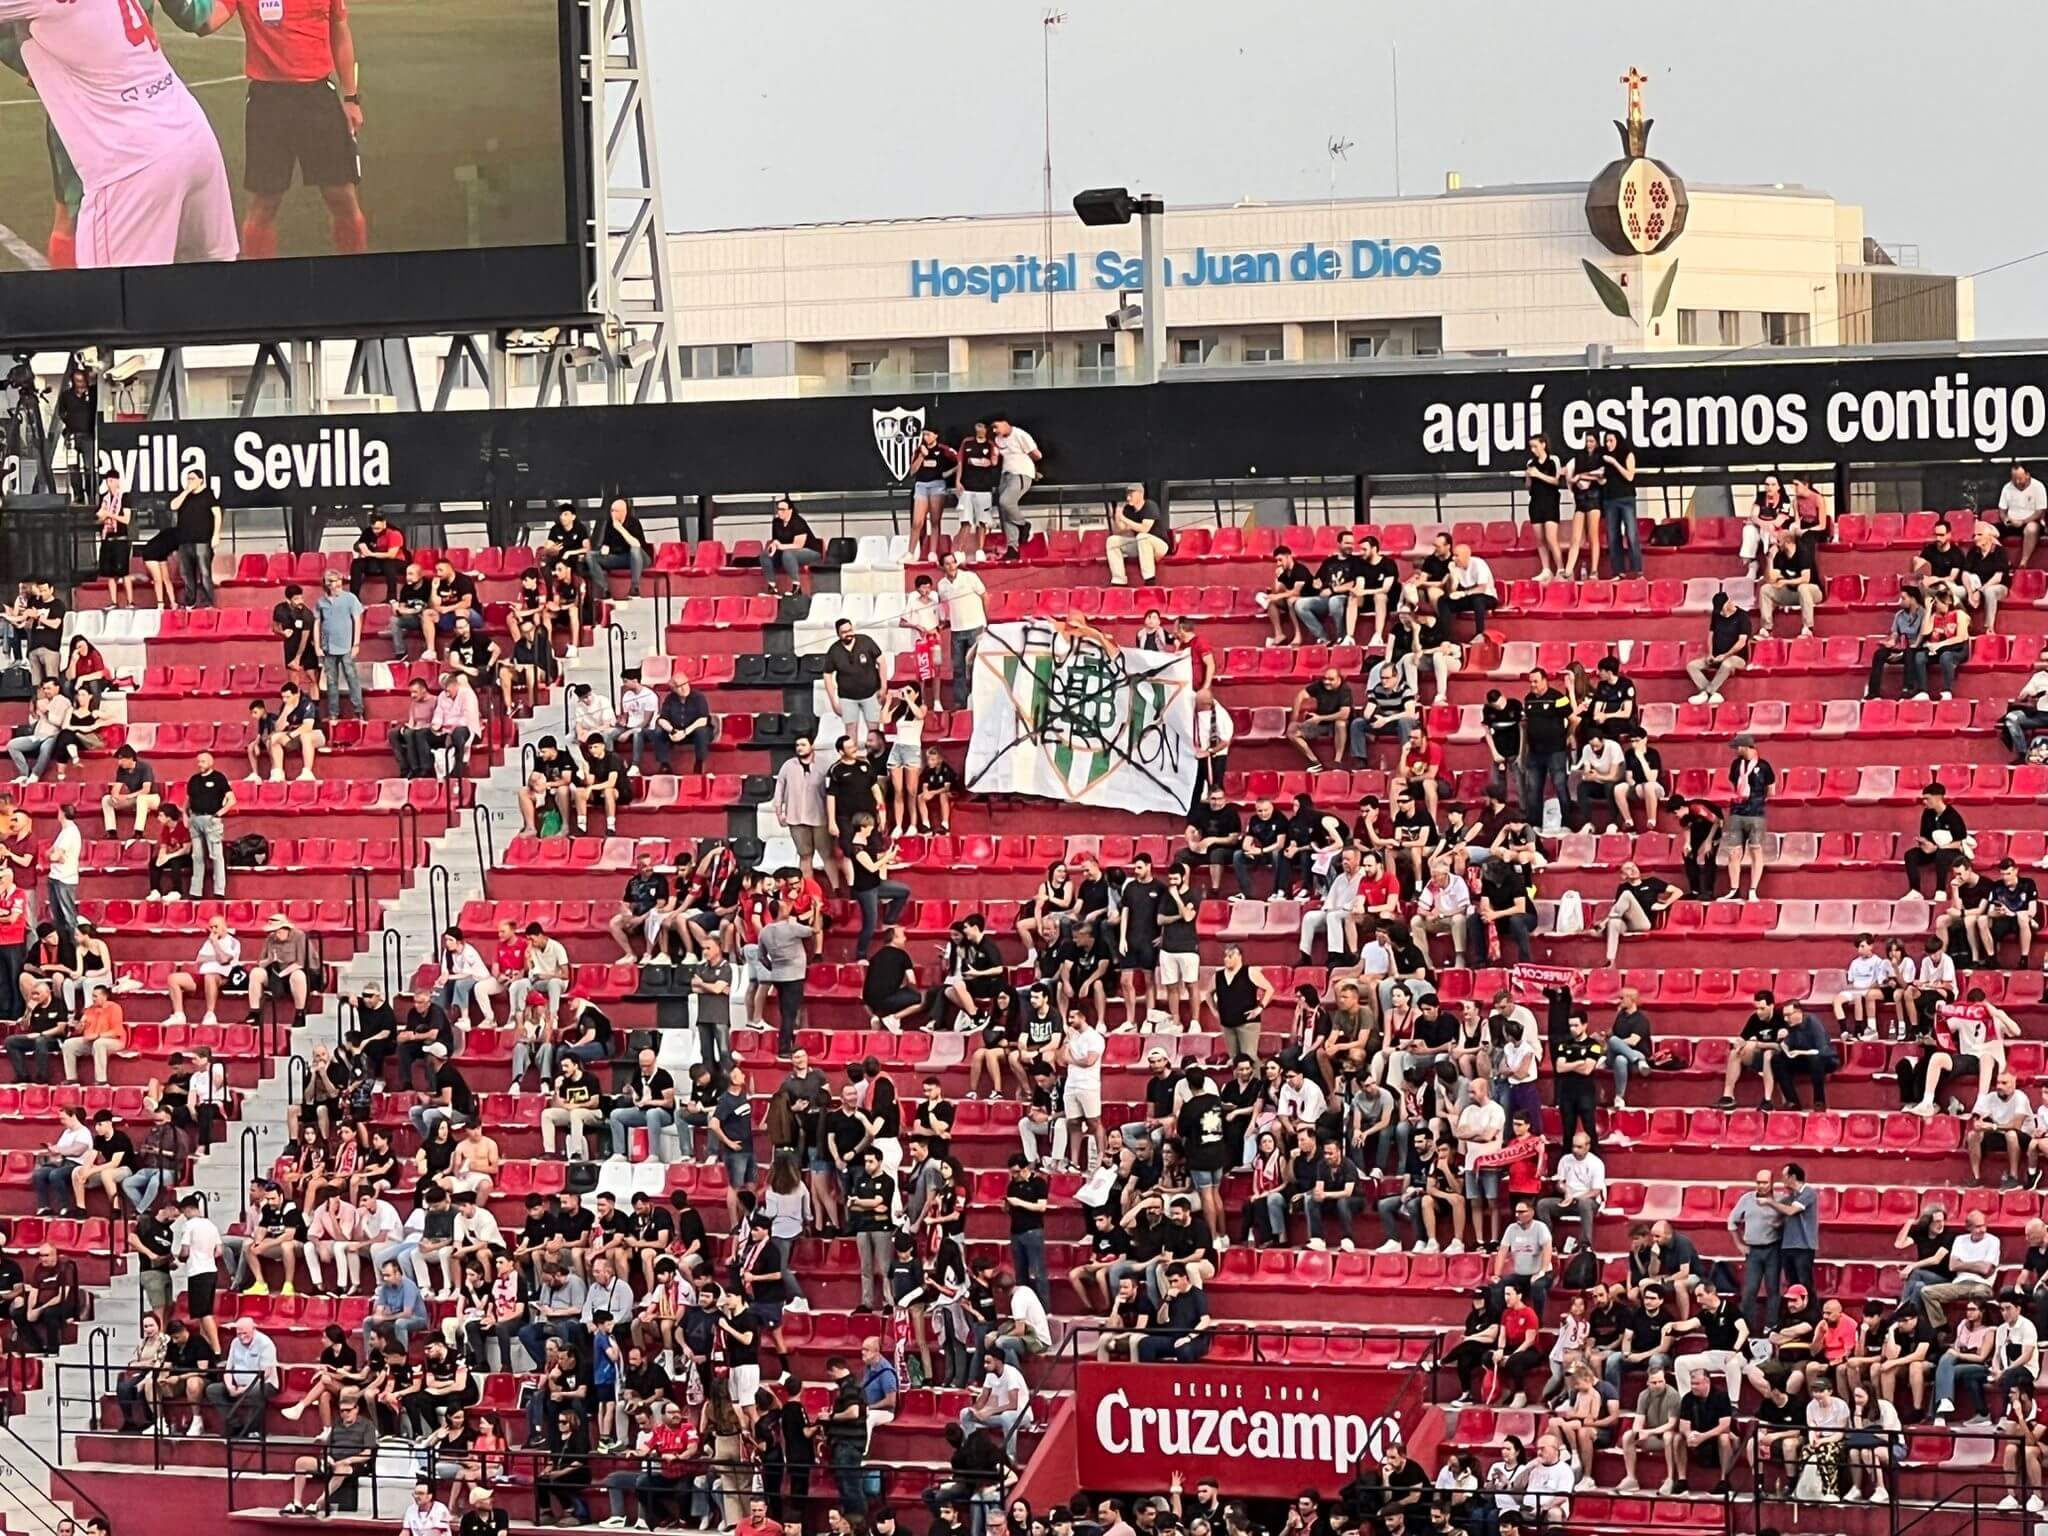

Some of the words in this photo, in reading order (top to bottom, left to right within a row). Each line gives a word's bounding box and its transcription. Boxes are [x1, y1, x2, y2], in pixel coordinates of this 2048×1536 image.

[912, 253, 1077, 302] Hospital
[1182, 247, 1279, 288] Juan
[1290, 242, 1341, 282] de
[1351, 239, 1442, 280] Dios
[1422, 384, 1545, 466] aquí
[1563, 386, 1808, 449] estamos
[1827, 373, 2046, 453] contigo
[97, 434, 221, 499] evilla,
[233, 428, 391, 490] Sevilla
[1095, 1387, 1402, 1474] Cruzcampo
